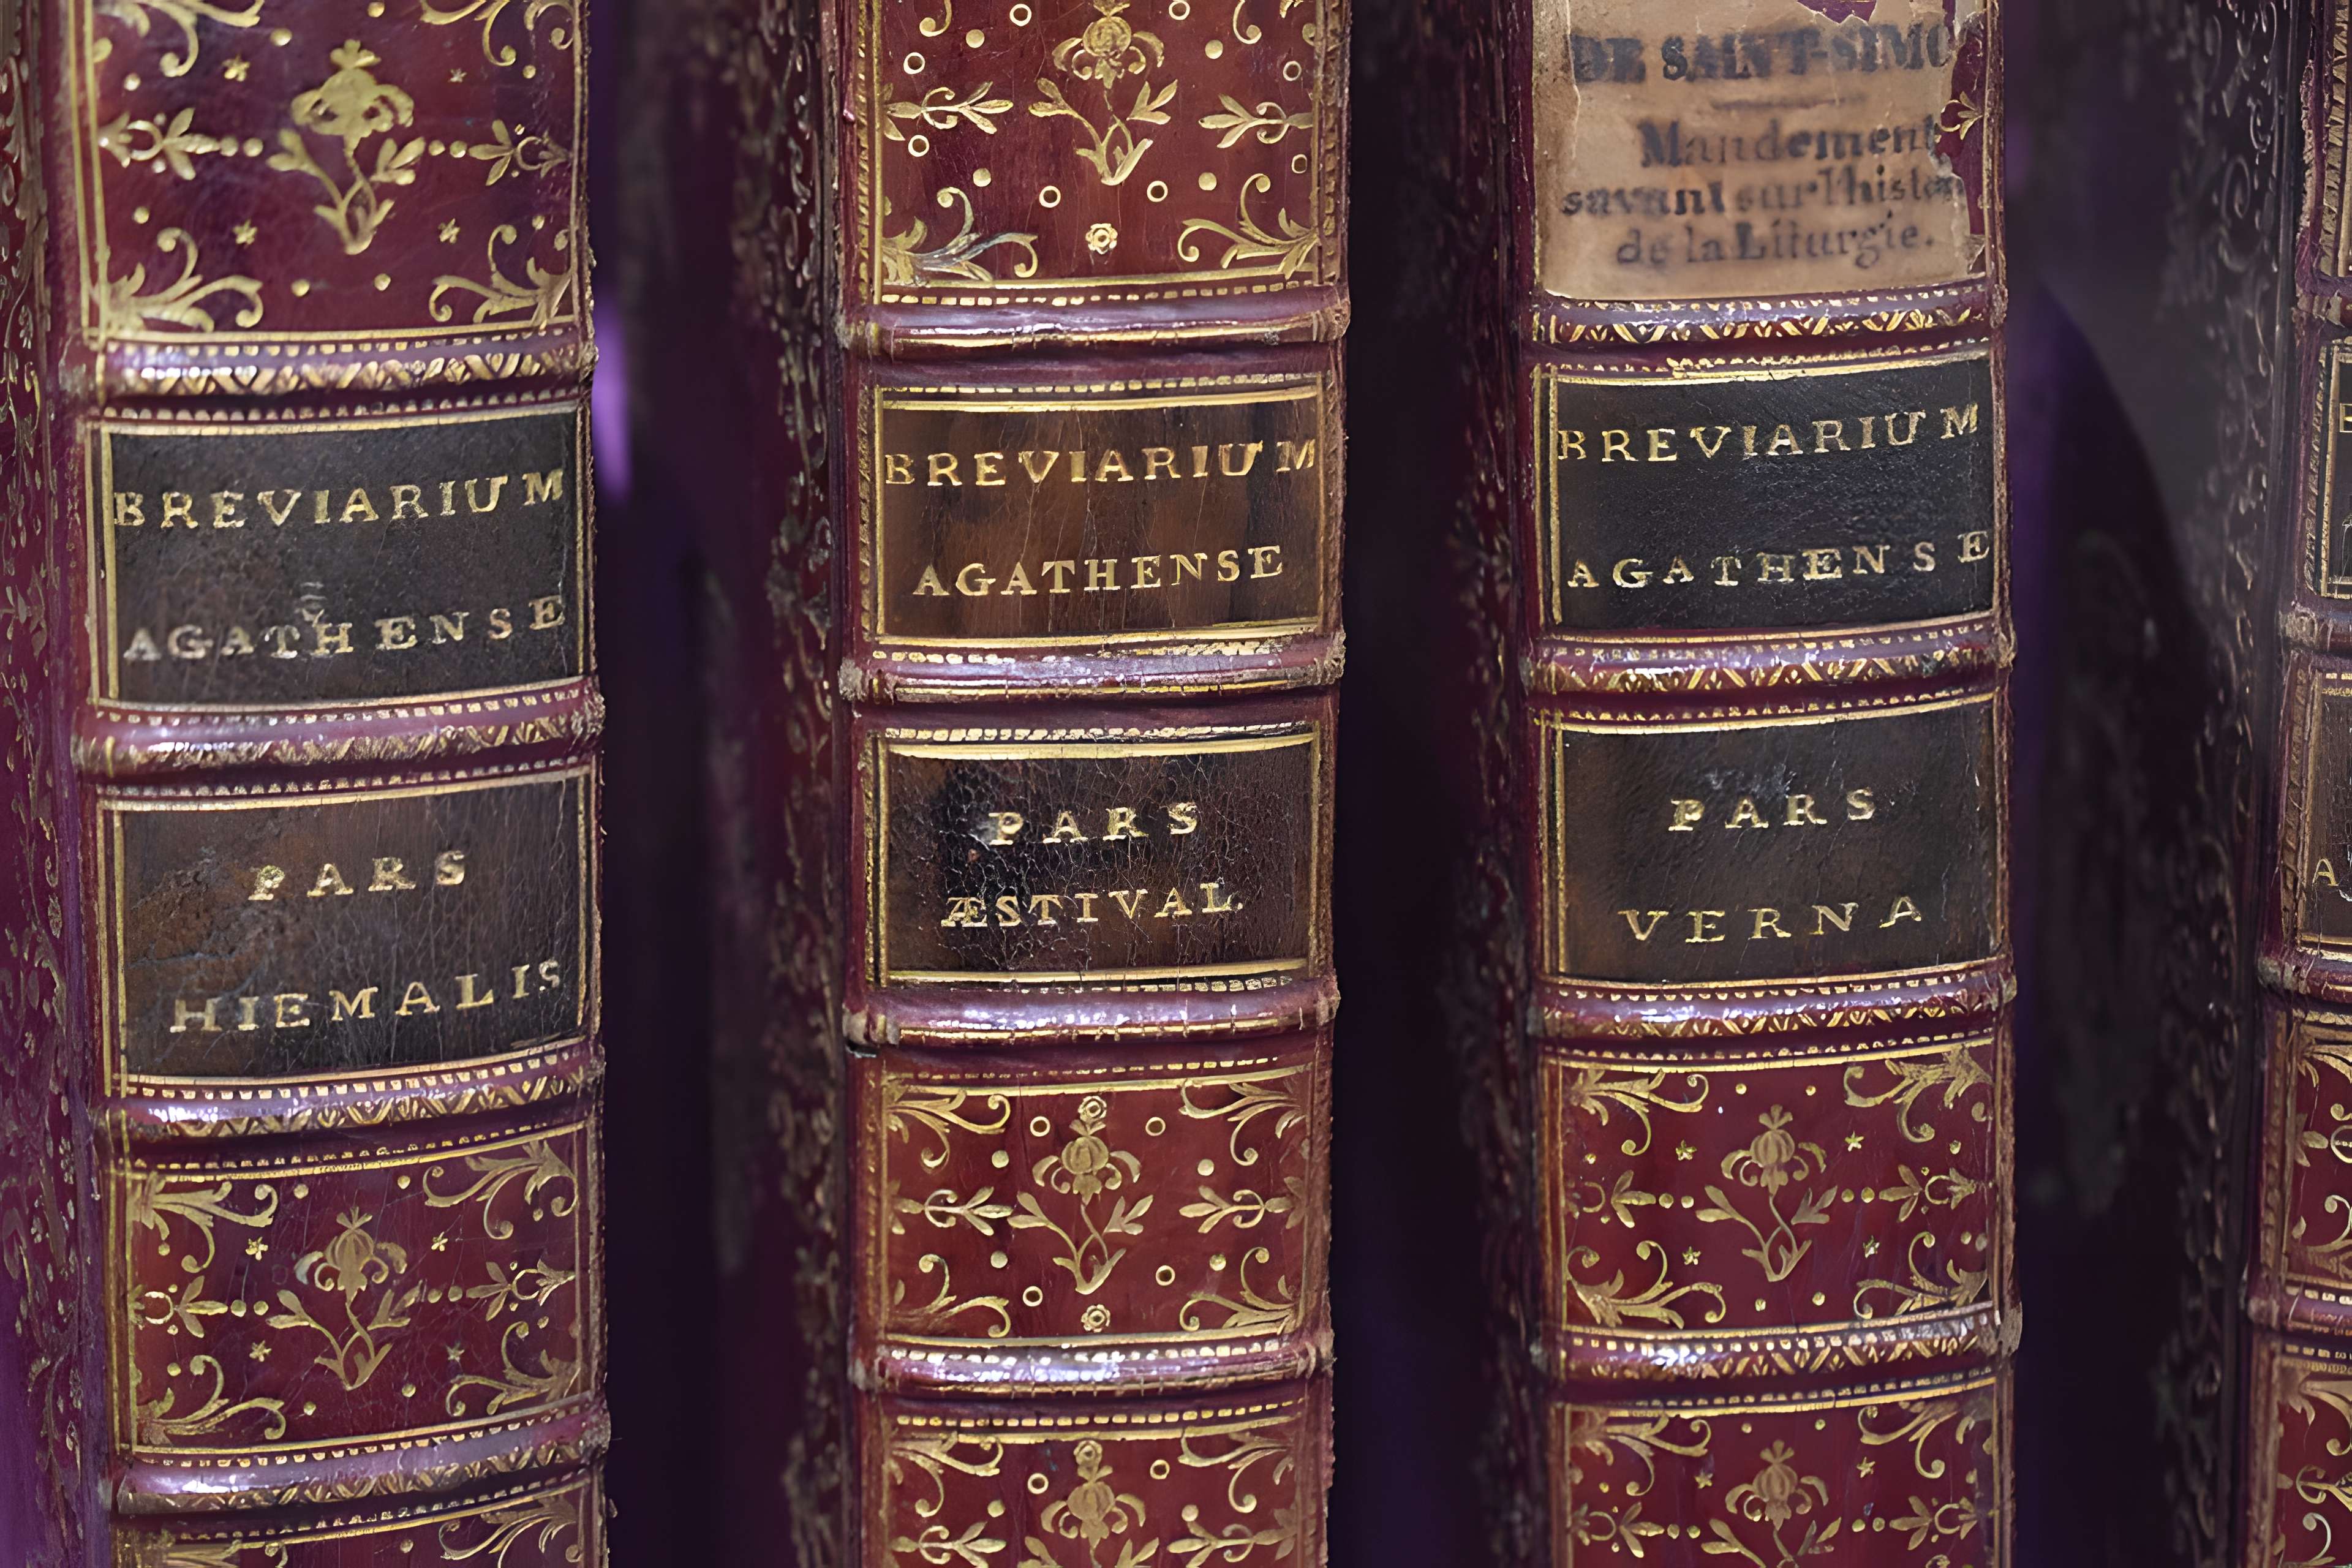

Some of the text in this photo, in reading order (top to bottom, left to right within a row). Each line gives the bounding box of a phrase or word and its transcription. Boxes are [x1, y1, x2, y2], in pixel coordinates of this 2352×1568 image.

[1570, 32, 1646, 83] DE
[1638, 113, 1934, 167] Mandement
[1561, 180, 1725, 216] savant
[1616, 227, 1668, 265] de
[1685, 222, 1725, 263] la
[1558, 403, 1978, 462] BREVIARIUM
[886, 438, 1315, 487] BREVIARIUM
[113, 468, 565, 529] BREVIARIUM
[912, 545, 1283, 597] AGATHENSE
[1567, 530, 1989, 588] AGATHENSE
[123, 594, 565, 661] AGATHENSE
[988, 802, 1199, 846] PARS
[1668, 786, 1875, 832] PARS
[247, 849, 467, 902] PARS
[1618, 895, 1922, 943] VERNA
[169, 959, 560, 1033] HIEMALIS
